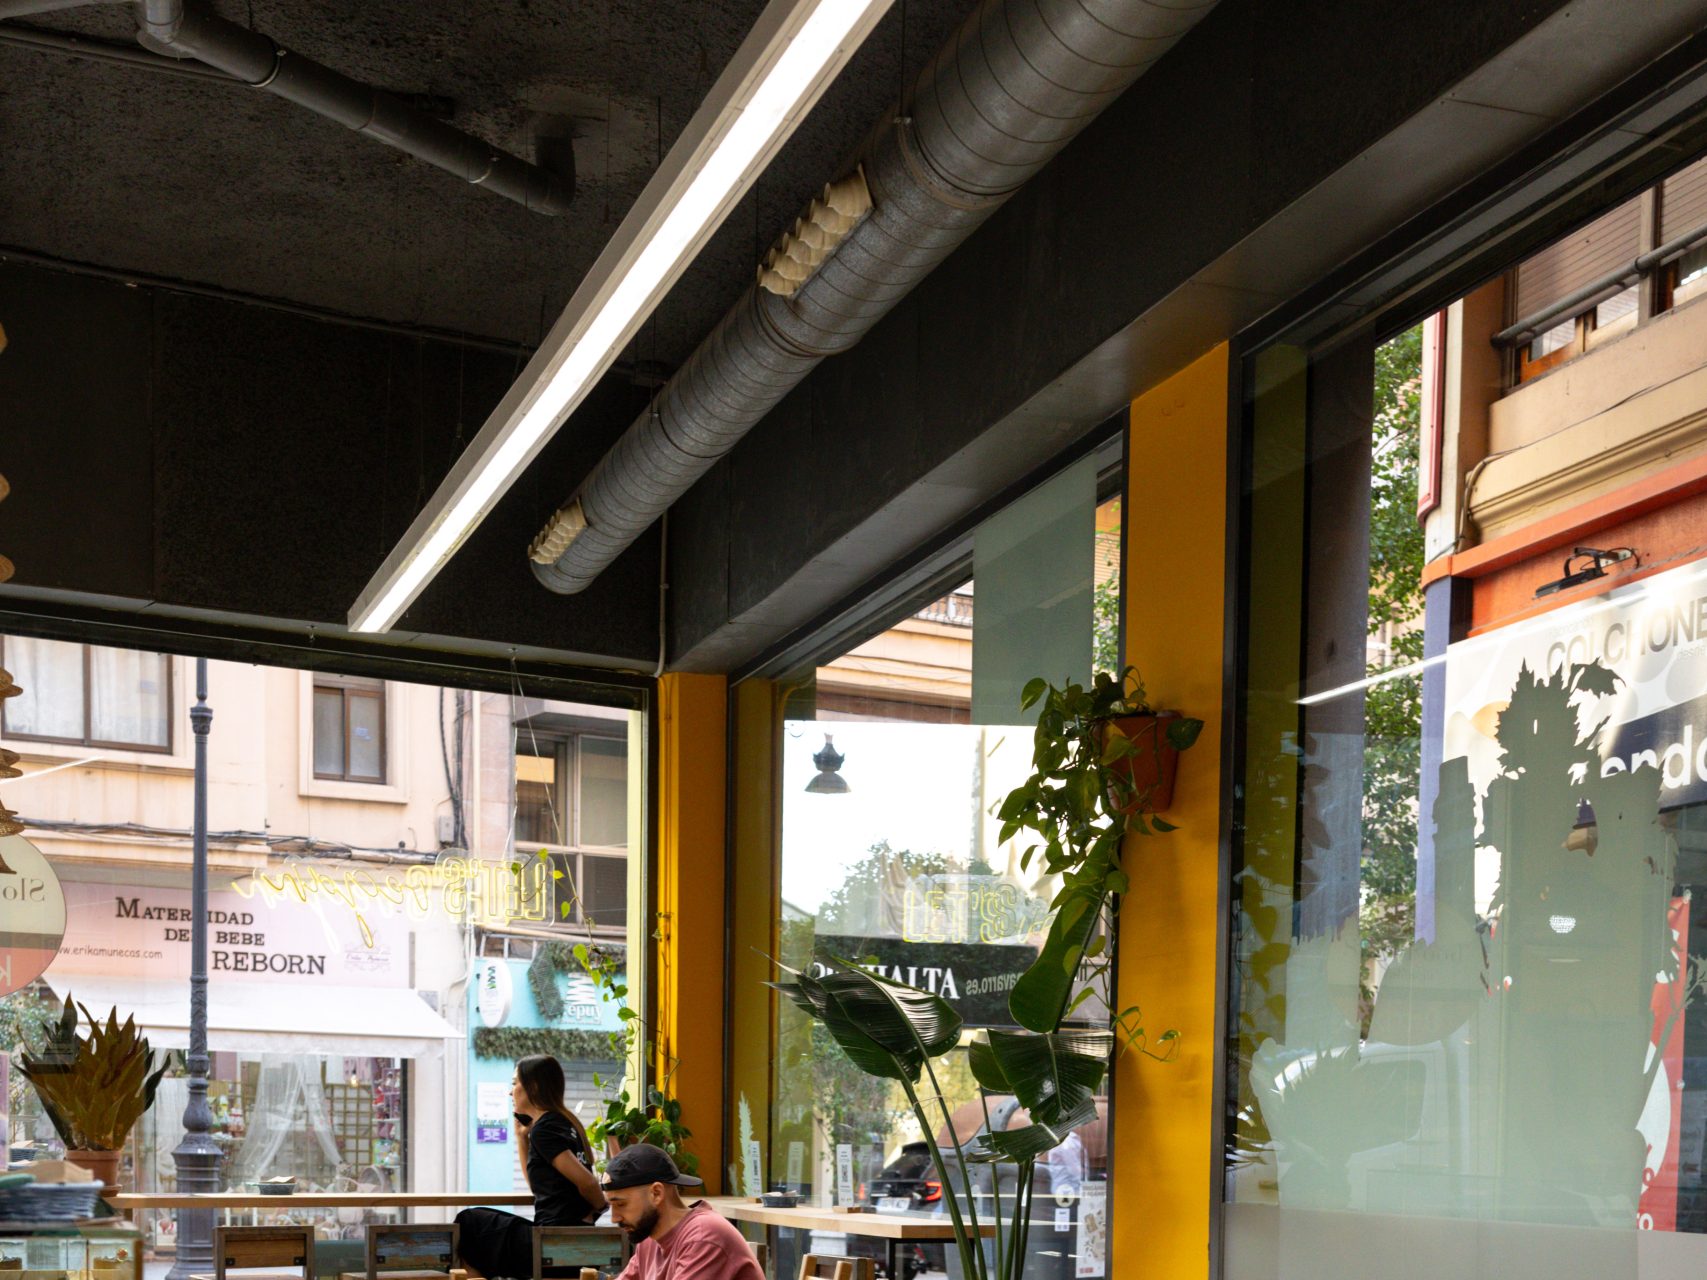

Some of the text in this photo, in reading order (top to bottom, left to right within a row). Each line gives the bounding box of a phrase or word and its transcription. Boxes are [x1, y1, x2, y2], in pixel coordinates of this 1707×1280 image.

[115, 897, 254, 926] MATERIDAD
[164, 928, 265, 947] DE BEBE
[211, 950, 326, 975] REBORN
